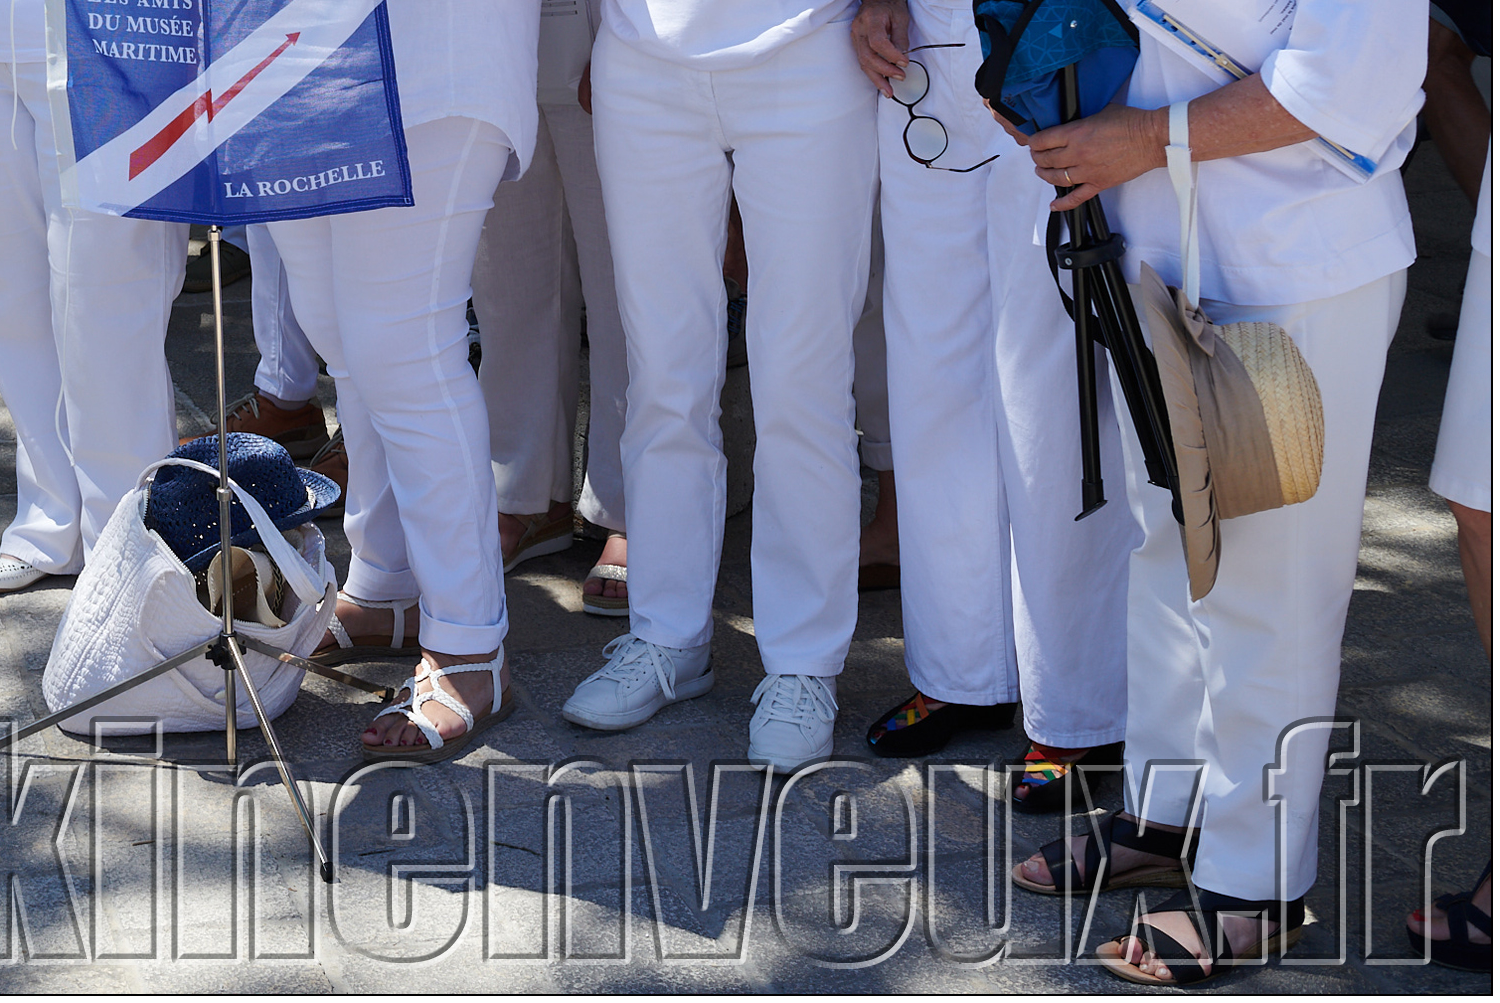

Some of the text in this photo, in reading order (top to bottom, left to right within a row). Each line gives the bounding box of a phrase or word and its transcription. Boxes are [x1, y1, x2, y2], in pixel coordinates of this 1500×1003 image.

[87, 12, 194, 37] DU MUSÉE
[92, 38, 197, 64] MARITIME
[224, 160, 386, 198] LA ROCHELLE
